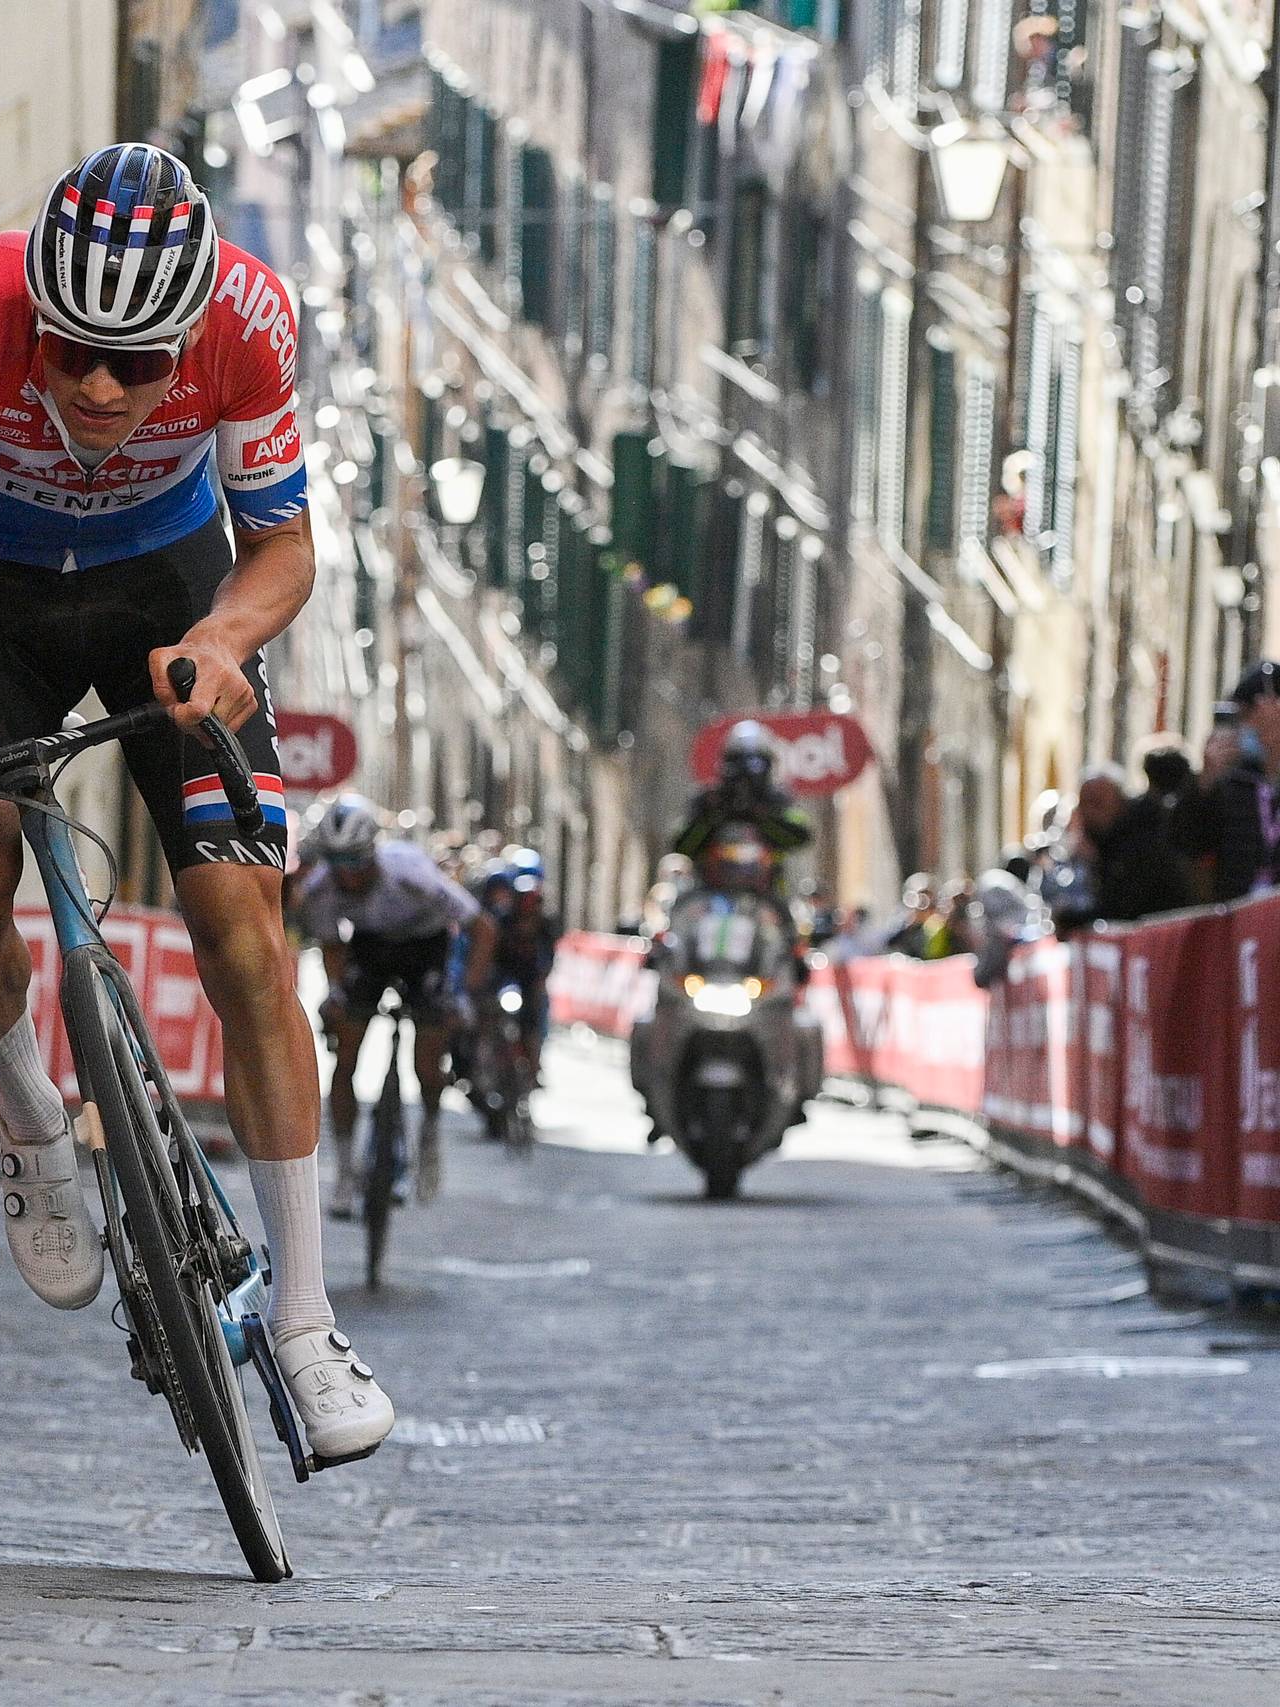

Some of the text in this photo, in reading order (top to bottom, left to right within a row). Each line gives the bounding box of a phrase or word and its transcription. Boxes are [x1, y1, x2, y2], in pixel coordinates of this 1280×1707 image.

[59, 260, 68, 289] FENIX
[149, 249, 177, 306] Alpecin FENIX
[228, 468, 276, 482] CAFFEINE
[195, 839, 288, 872] CAN
